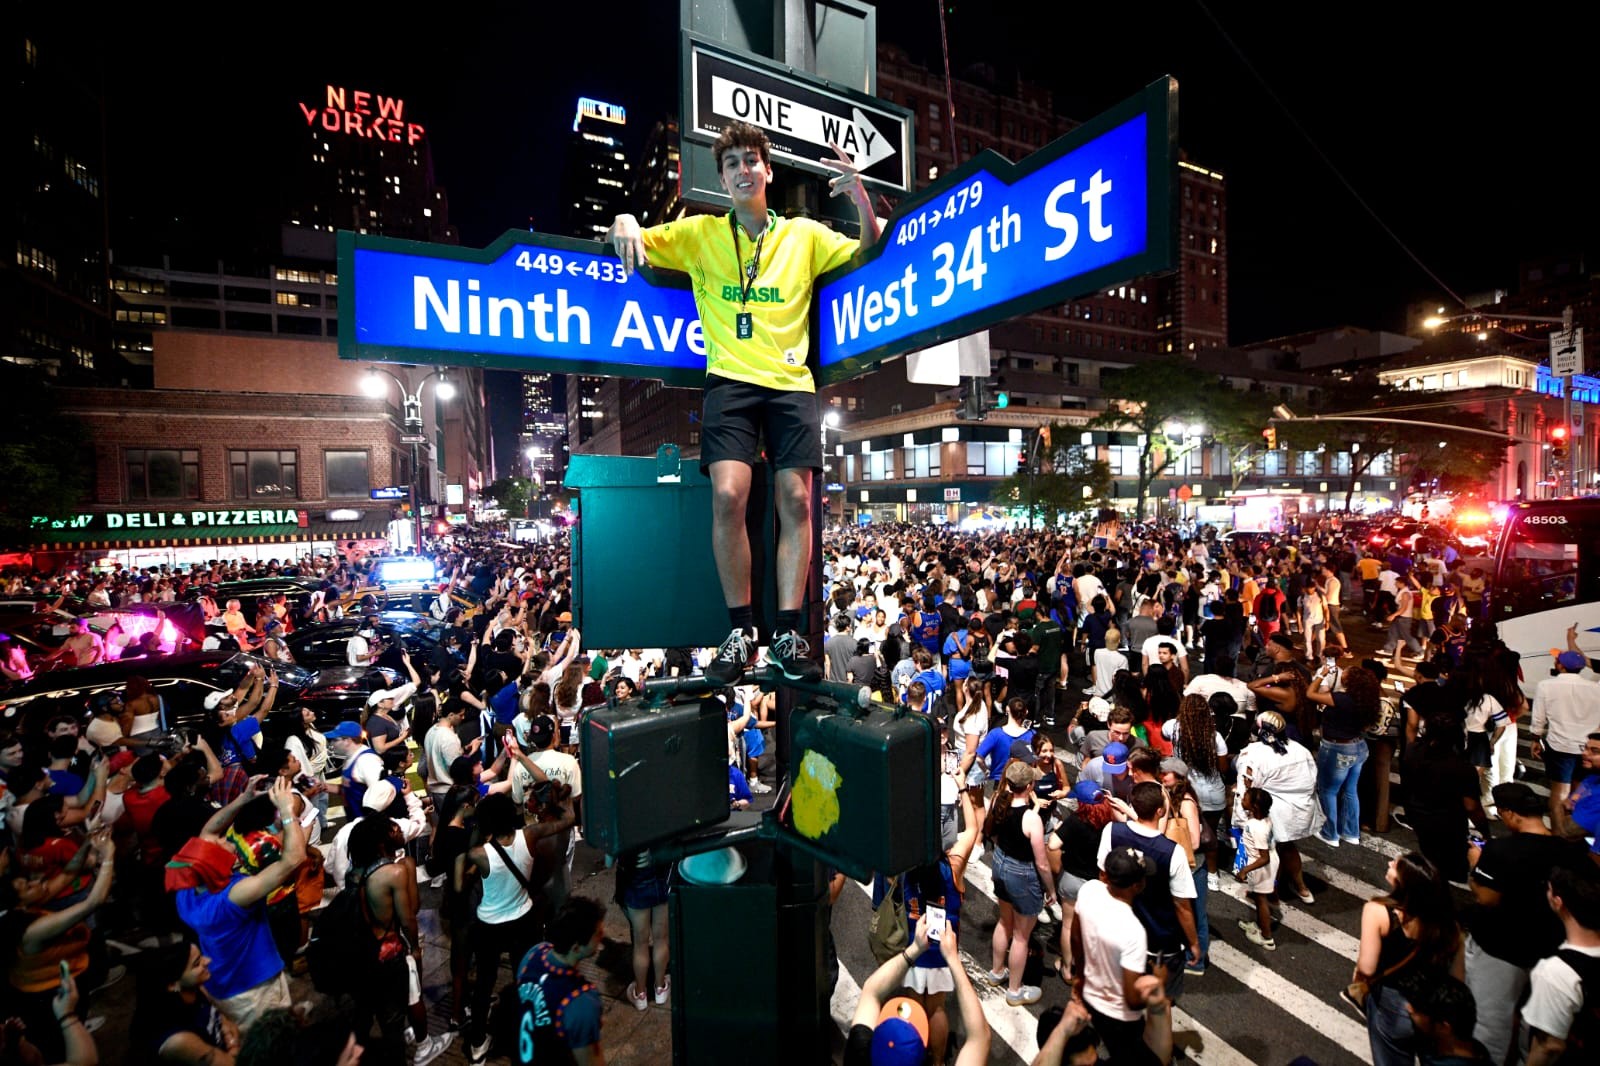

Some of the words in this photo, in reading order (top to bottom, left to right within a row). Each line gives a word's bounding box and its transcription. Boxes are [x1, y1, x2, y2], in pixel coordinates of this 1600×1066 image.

[327, 84, 403, 121] NEW
[732, 87, 793, 132] ONE
[821, 115, 876, 157] WAY
[896, 212, 928, 246] 401
[943, 180, 983, 219] 479
[516, 251, 563, 275] 449
[585, 260, 628, 284] 433
[831, 263, 918, 346] West
[931, 205, 1021, 307] 34th
[1045, 169, 1113, 261] St
[413, 275, 591, 345] Ninth
[611, 300, 707, 356] Ave
[721, 285, 785, 303] BRASIL
[106, 512, 165, 528] DELI
[172, 513, 186, 526] &
[191, 509, 299, 526] PIZZERIA
[1523, 515, 1567, 525] 48503
[519, 1010, 535, 1064] 6
